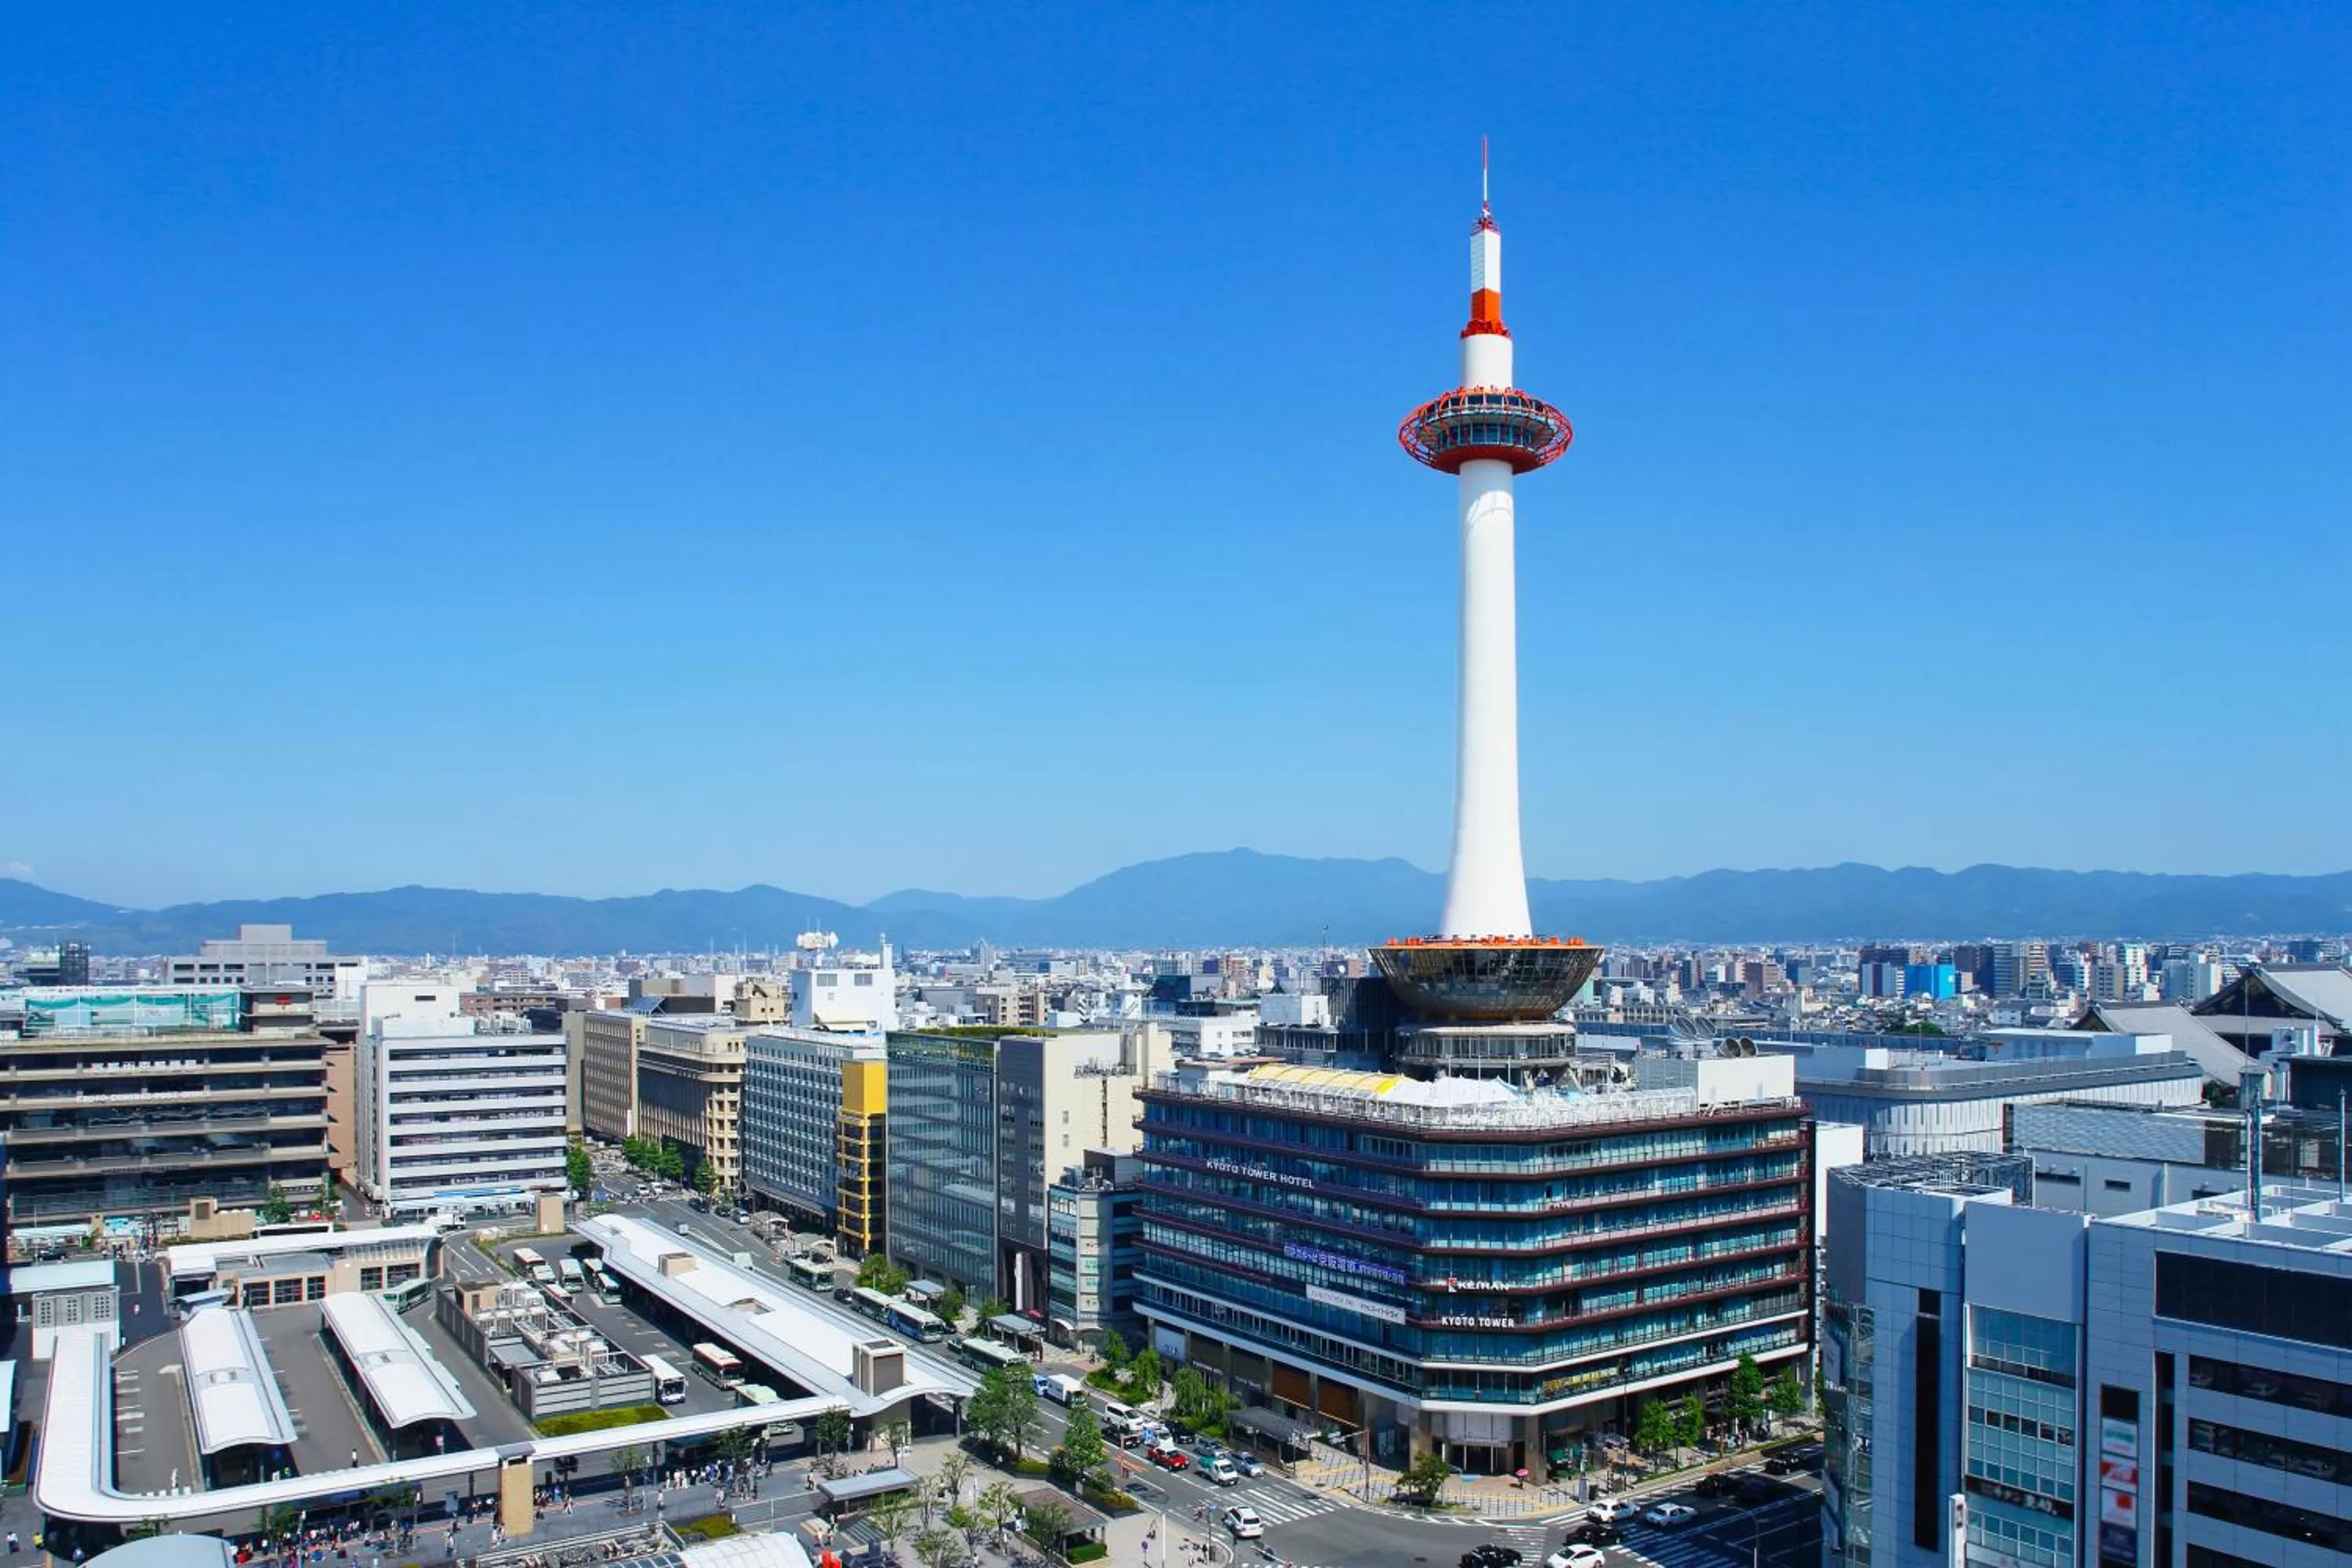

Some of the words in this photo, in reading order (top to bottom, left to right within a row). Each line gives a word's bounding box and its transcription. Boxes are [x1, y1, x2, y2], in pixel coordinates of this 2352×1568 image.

[1207, 1160, 1239, 1174] KYOTO
[1241, 1166, 1277, 1181] TOWER
[1280, 1174, 1315, 1189] HOTEL
[1443, 1316, 1475, 1327] KYOTO
[1478, 1318, 1515, 1328] TOWER
